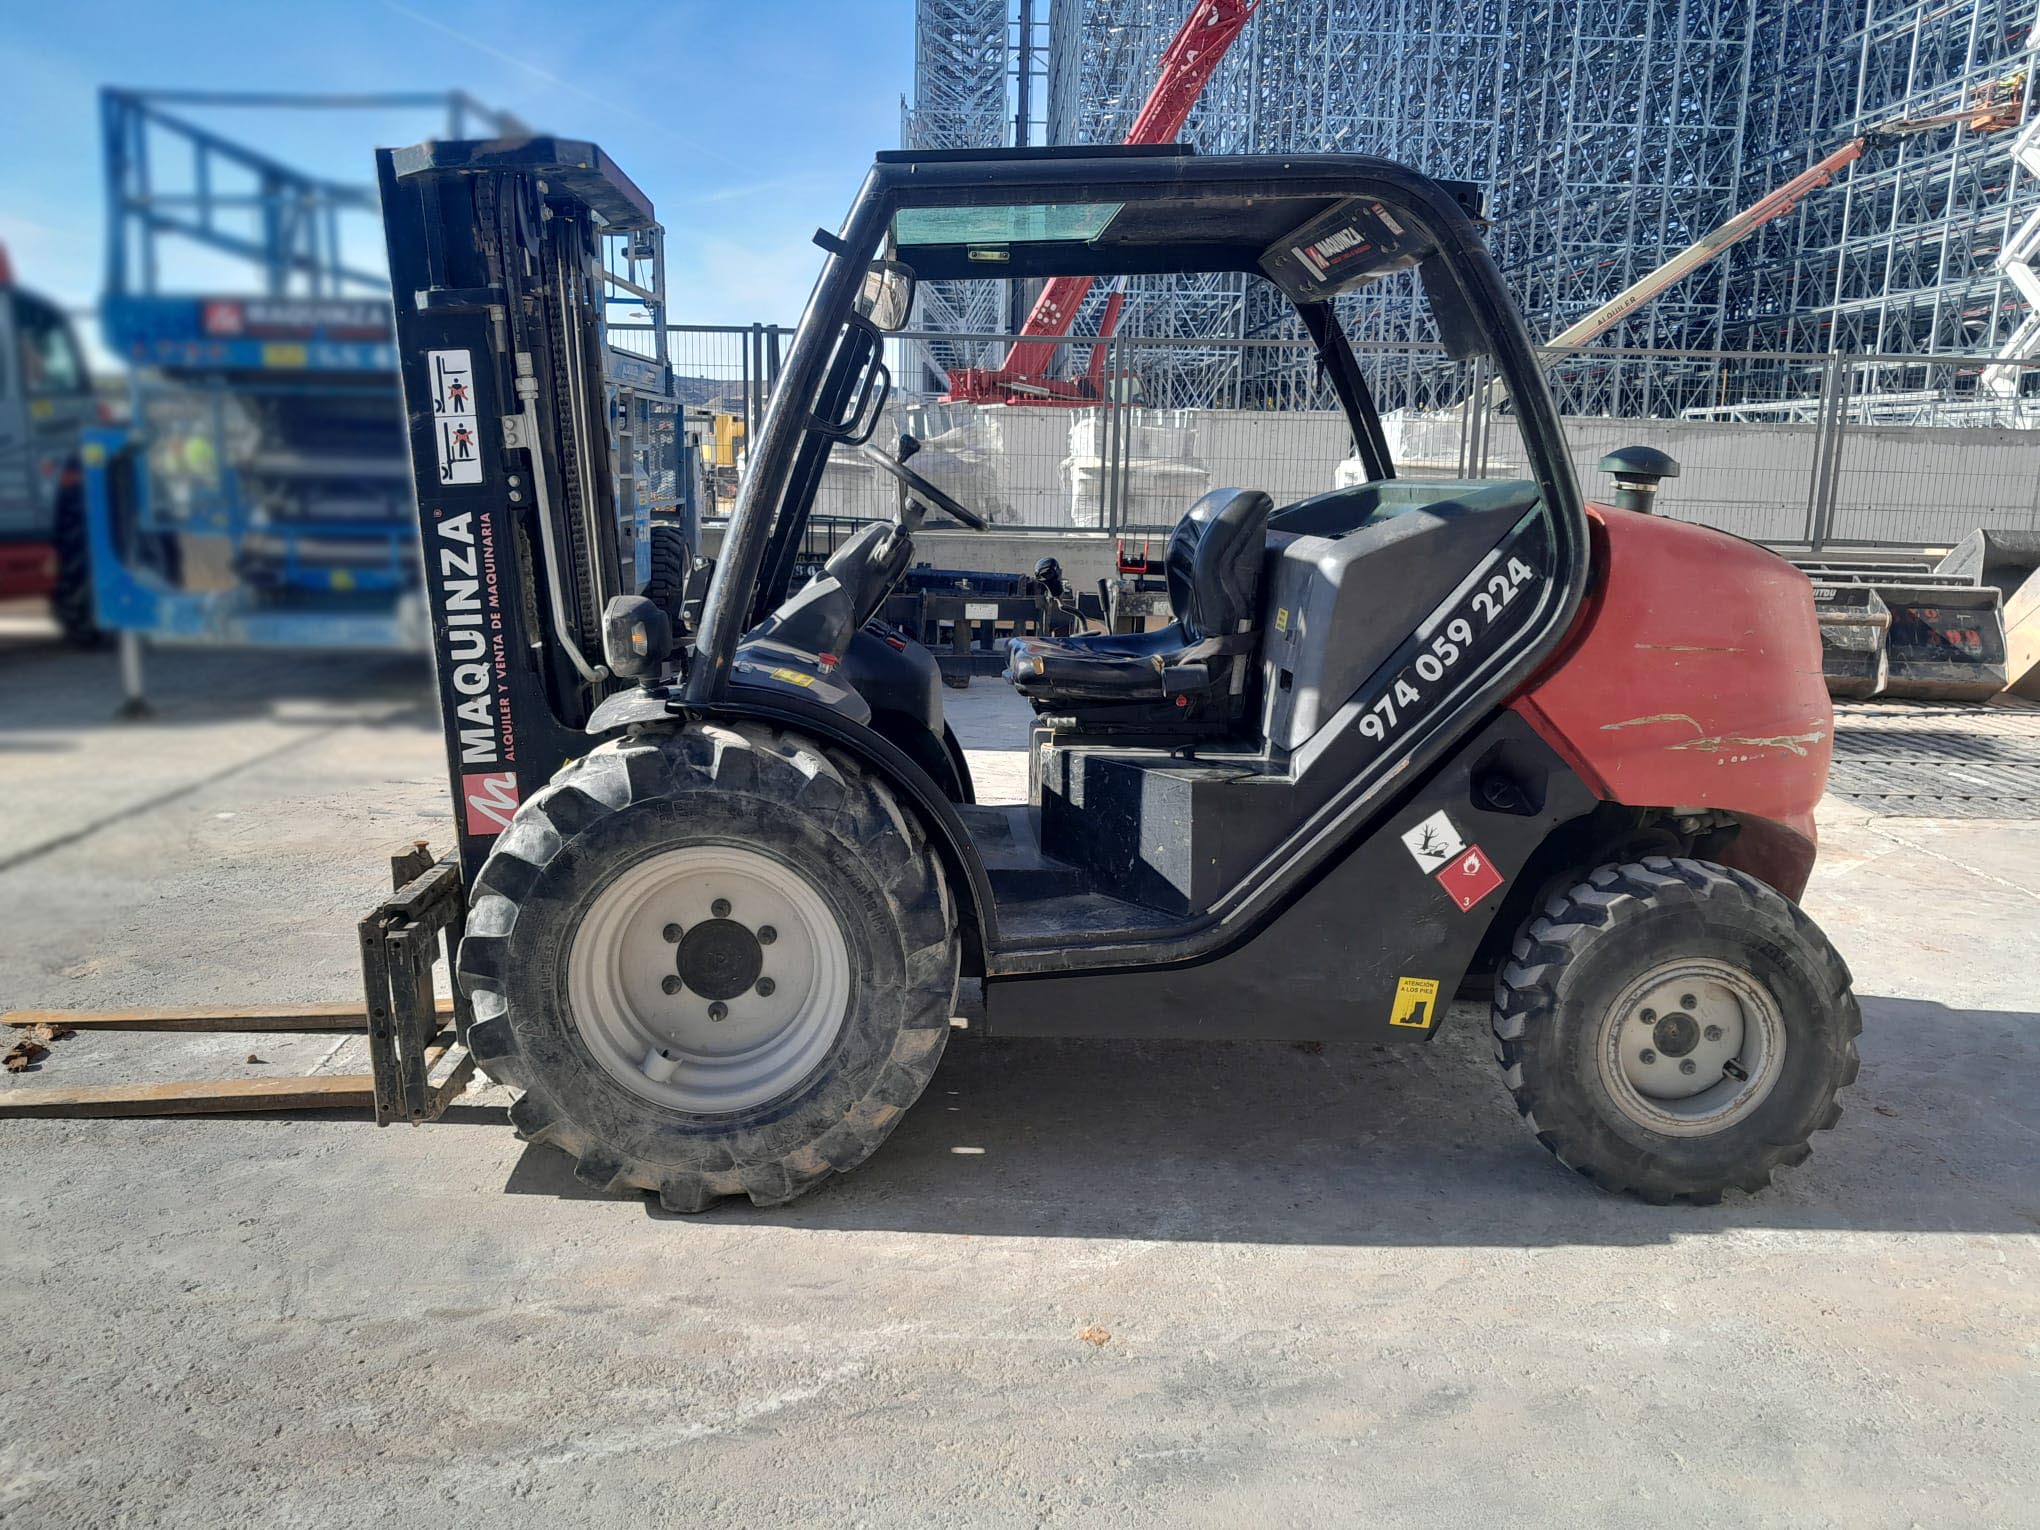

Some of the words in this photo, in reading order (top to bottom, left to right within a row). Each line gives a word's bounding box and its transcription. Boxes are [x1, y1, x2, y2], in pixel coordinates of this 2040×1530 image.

[1314, 226, 1366, 258] MAQUINZA
[480, 512, 500, 608] MAQUINARIA
[437, 511, 498, 764] MAQUINZA
[489, 612, 502, 630] DE
[493, 634, 508, 680] VENTA
[1359, 679, 1421, 742] 974
[1415, 618, 1473, 682] 059
[1471, 556, 1534, 624] 224
[498, 684, 509, 693] Y
[499, 697, 516, 762] ALQUILER
[1463, 896, 1470, 907] 3
[1404, 980, 1434, 988] ATENCIÓN
